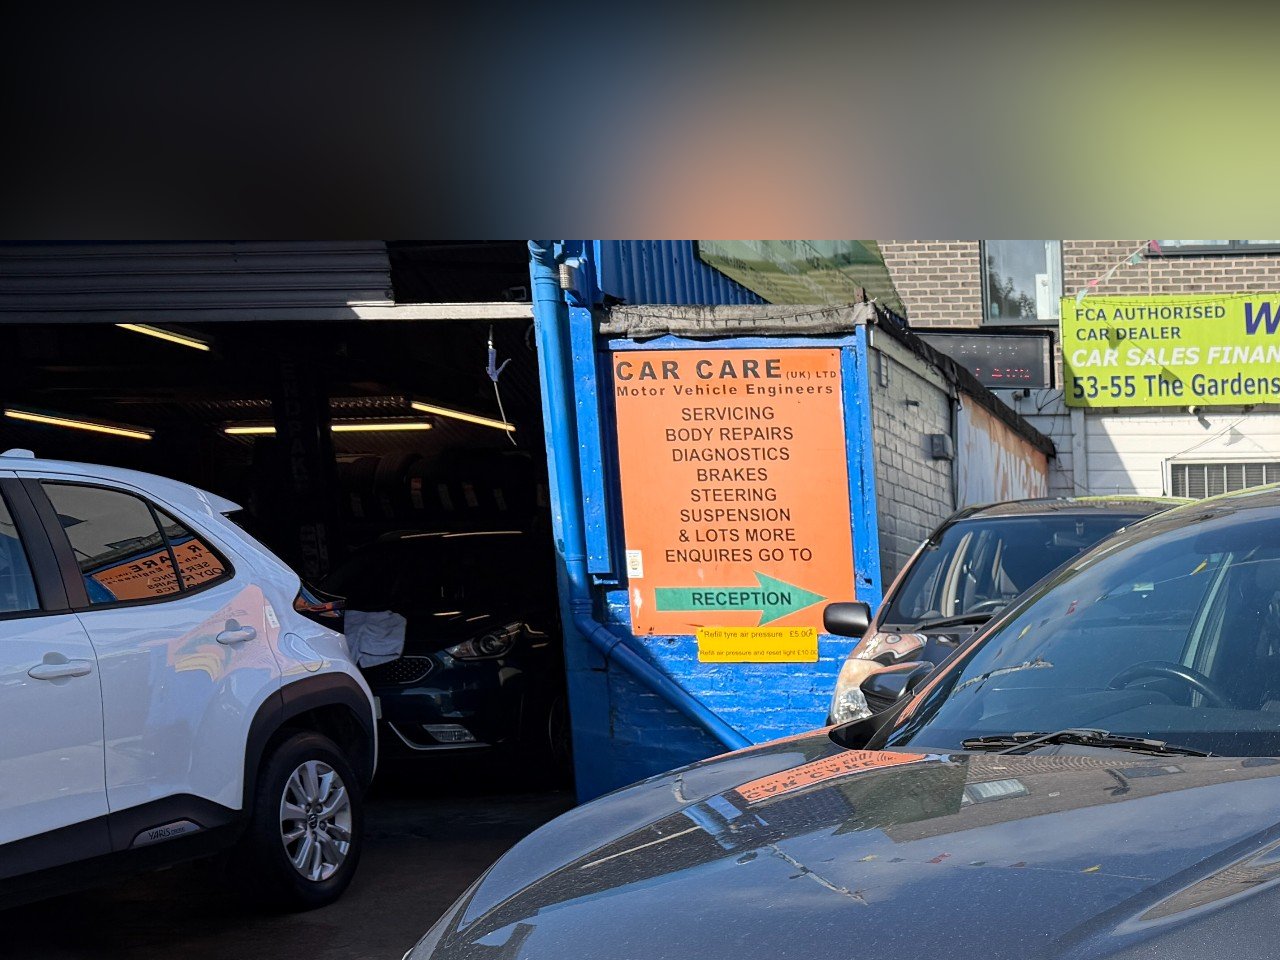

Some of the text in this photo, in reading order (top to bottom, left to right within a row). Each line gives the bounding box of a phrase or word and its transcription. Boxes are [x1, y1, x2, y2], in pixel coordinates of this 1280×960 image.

[1075, 305, 1226, 322] FCA AUTHORISED
[1076, 326, 1181, 341] CAR DEALER
[1072, 348, 1118, 368] CAR
[1123, 347, 1200, 367] SALES
[616, 359, 837, 381] CAR CARE (UK) LTD
[617, 383, 833, 397] Motor Vehicle Engineers
[1072, 375, 1136, 399] 53-55
[1143, 374, 1183, 397] The
[682, 406, 775, 421] SERVICING
[665, 427, 794, 442] BODY REPAIRS
[672, 447, 790, 462] DIAGNOSTICS
[697, 468, 768, 482] BRAKES
[691, 488, 777, 502] STEERING
[680, 508, 791, 523] SUSPENSION
[678, 528, 796, 543] & LOTS MORE
[665, 548, 813, 563] ENQUIRES GO TO
[692, 591, 792, 606] RECEPTION
[724, 631, 737, 640] tyre
[751, 631, 783, 640] pressure
